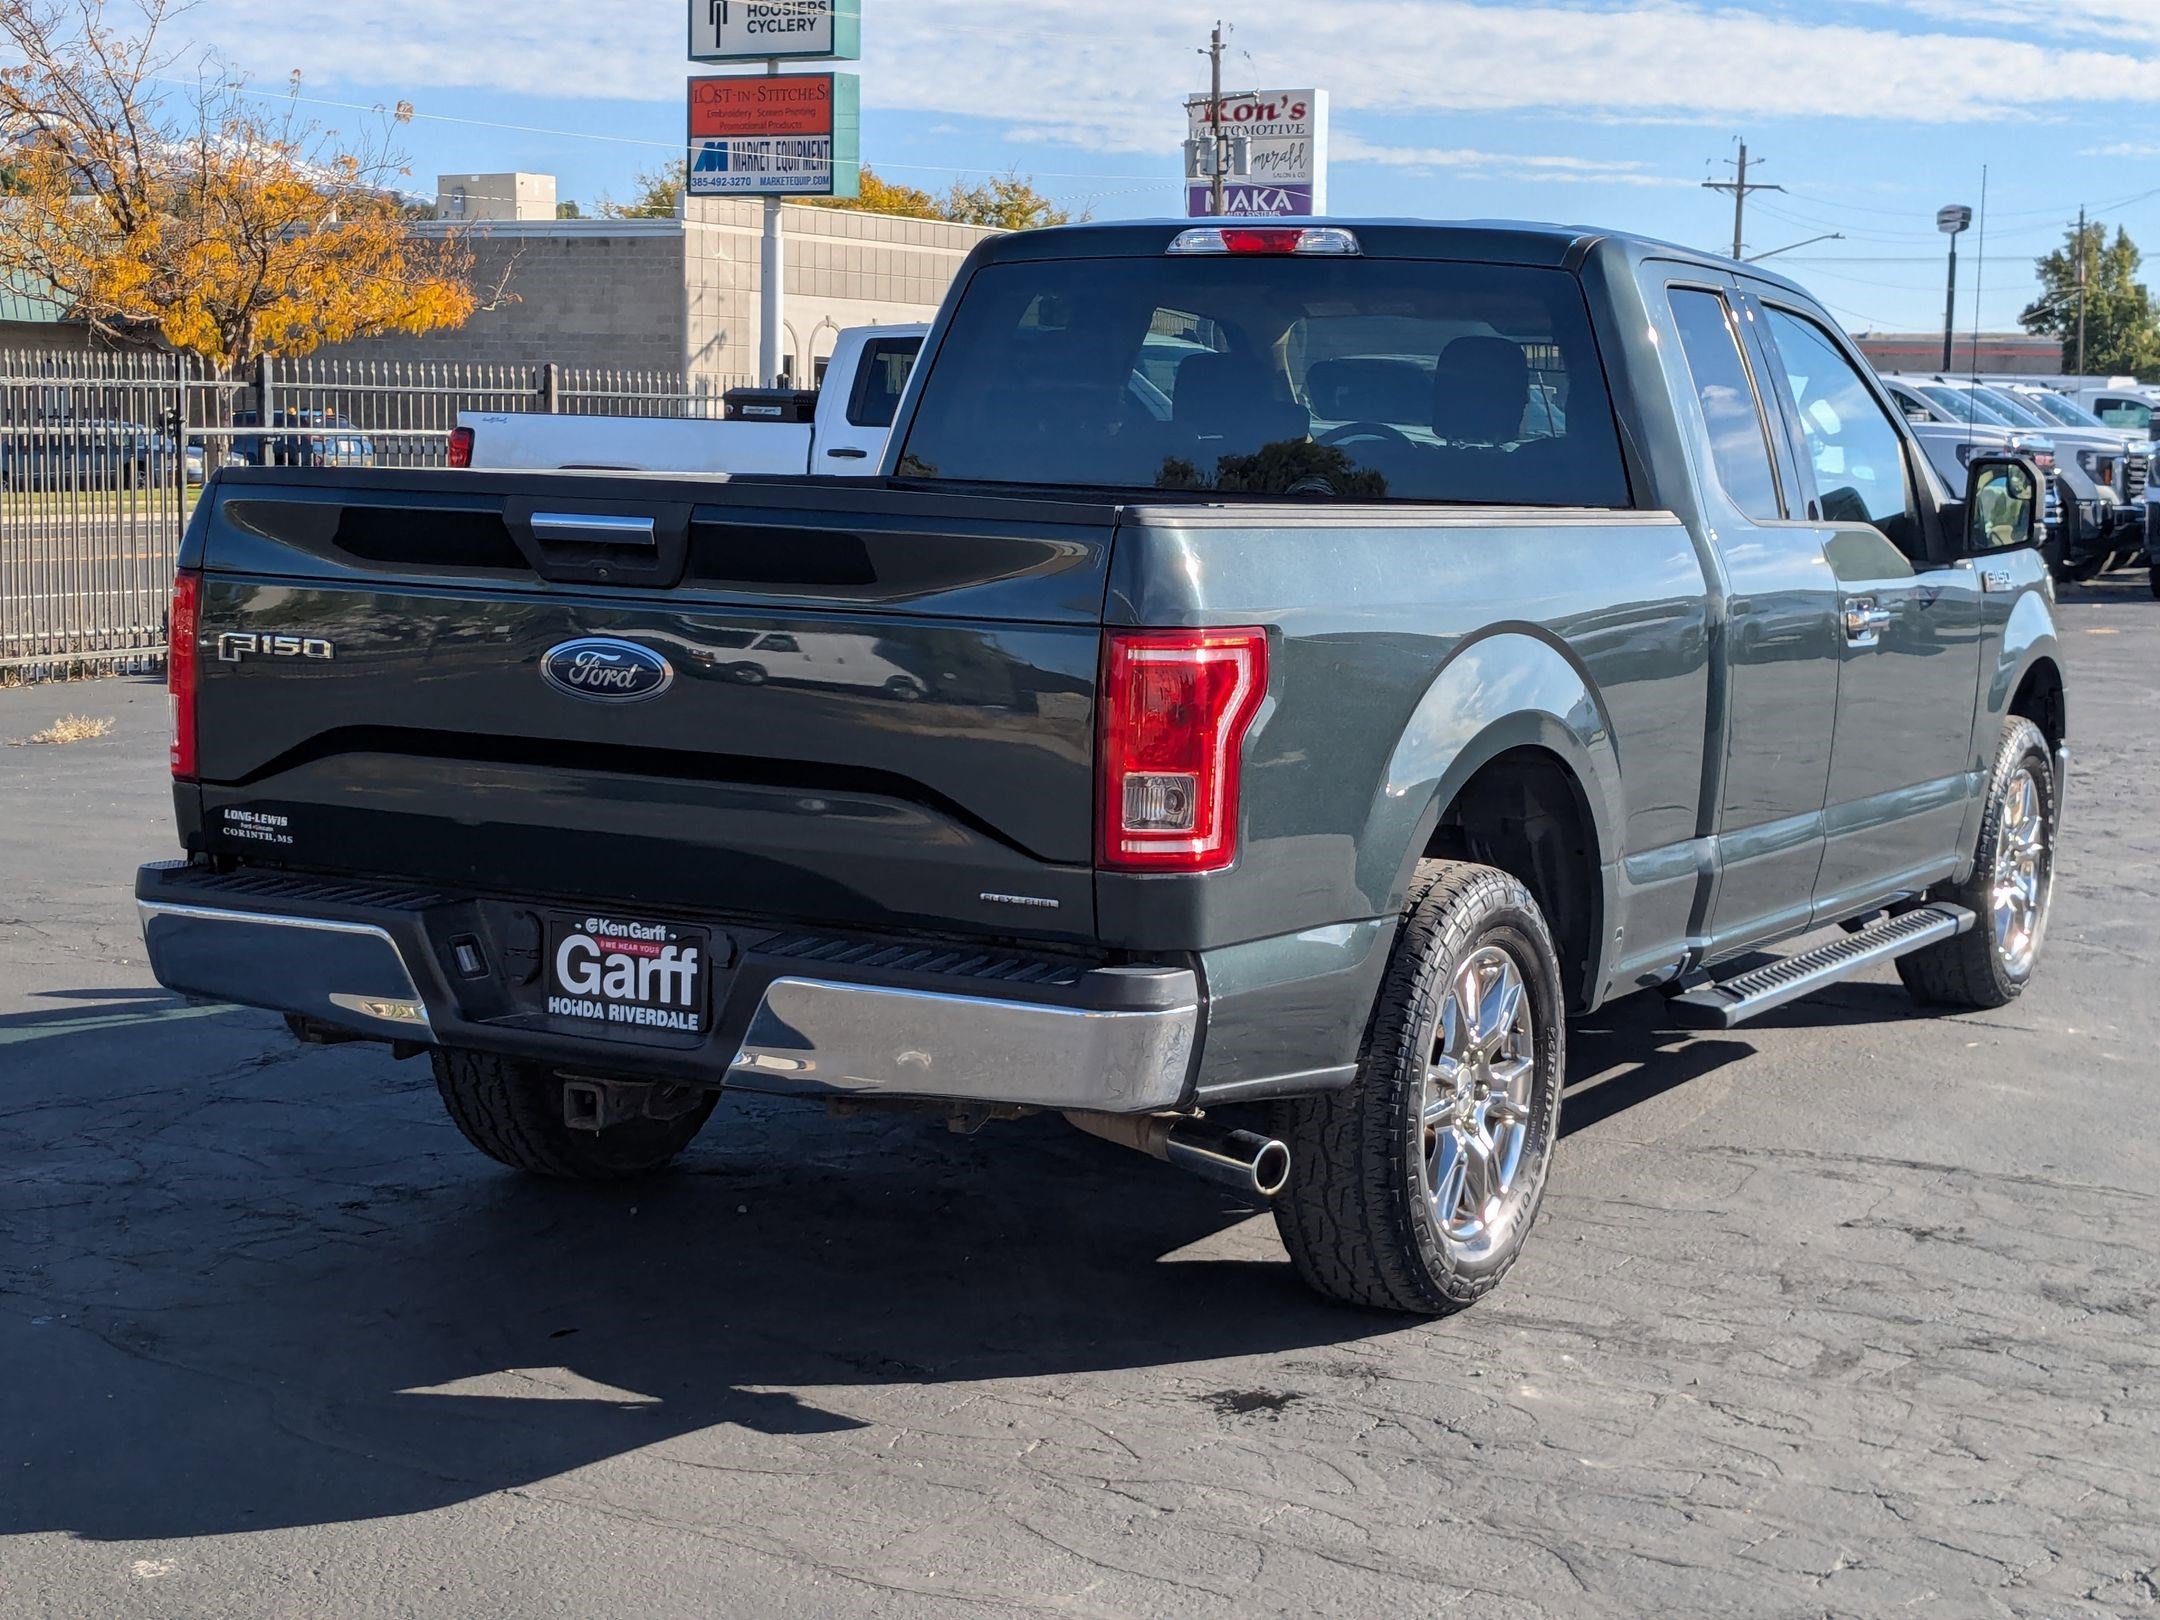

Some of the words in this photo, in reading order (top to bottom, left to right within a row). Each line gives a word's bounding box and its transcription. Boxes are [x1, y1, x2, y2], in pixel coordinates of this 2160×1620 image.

[747, 1, 827, 17] HOOSIERS
[747, 18, 817, 33] CYCLERY
[707, 109, 751, 118] Embroidery
[757, 108, 783, 117] Screen
[785, 107, 816, 117] Printing
[719, 121, 767, 129] Promotional
[768, 120, 802, 128] Products
[732, 142, 770, 171] MARKET
[776, 141, 829, 172] EQUIPMENT
[692, 177, 751, 186] 385-492-3270
[760, 176, 829, 186] MARKETEQUIP.COM
[569, 651, 638, 688] Ford
[224, 809, 288, 827] LONG-LEWIS
[599, 918, 628, 937] Ken
[629, 922, 666, 941] Garff
[606, 941, 617, 949] WE
[619, 942, 638, 951] HEAR
[556, 934, 698, 1006] Garff
[549, 997, 604, 1020] HONDA
[608, 1004, 699, 1031] RIVERDALE
